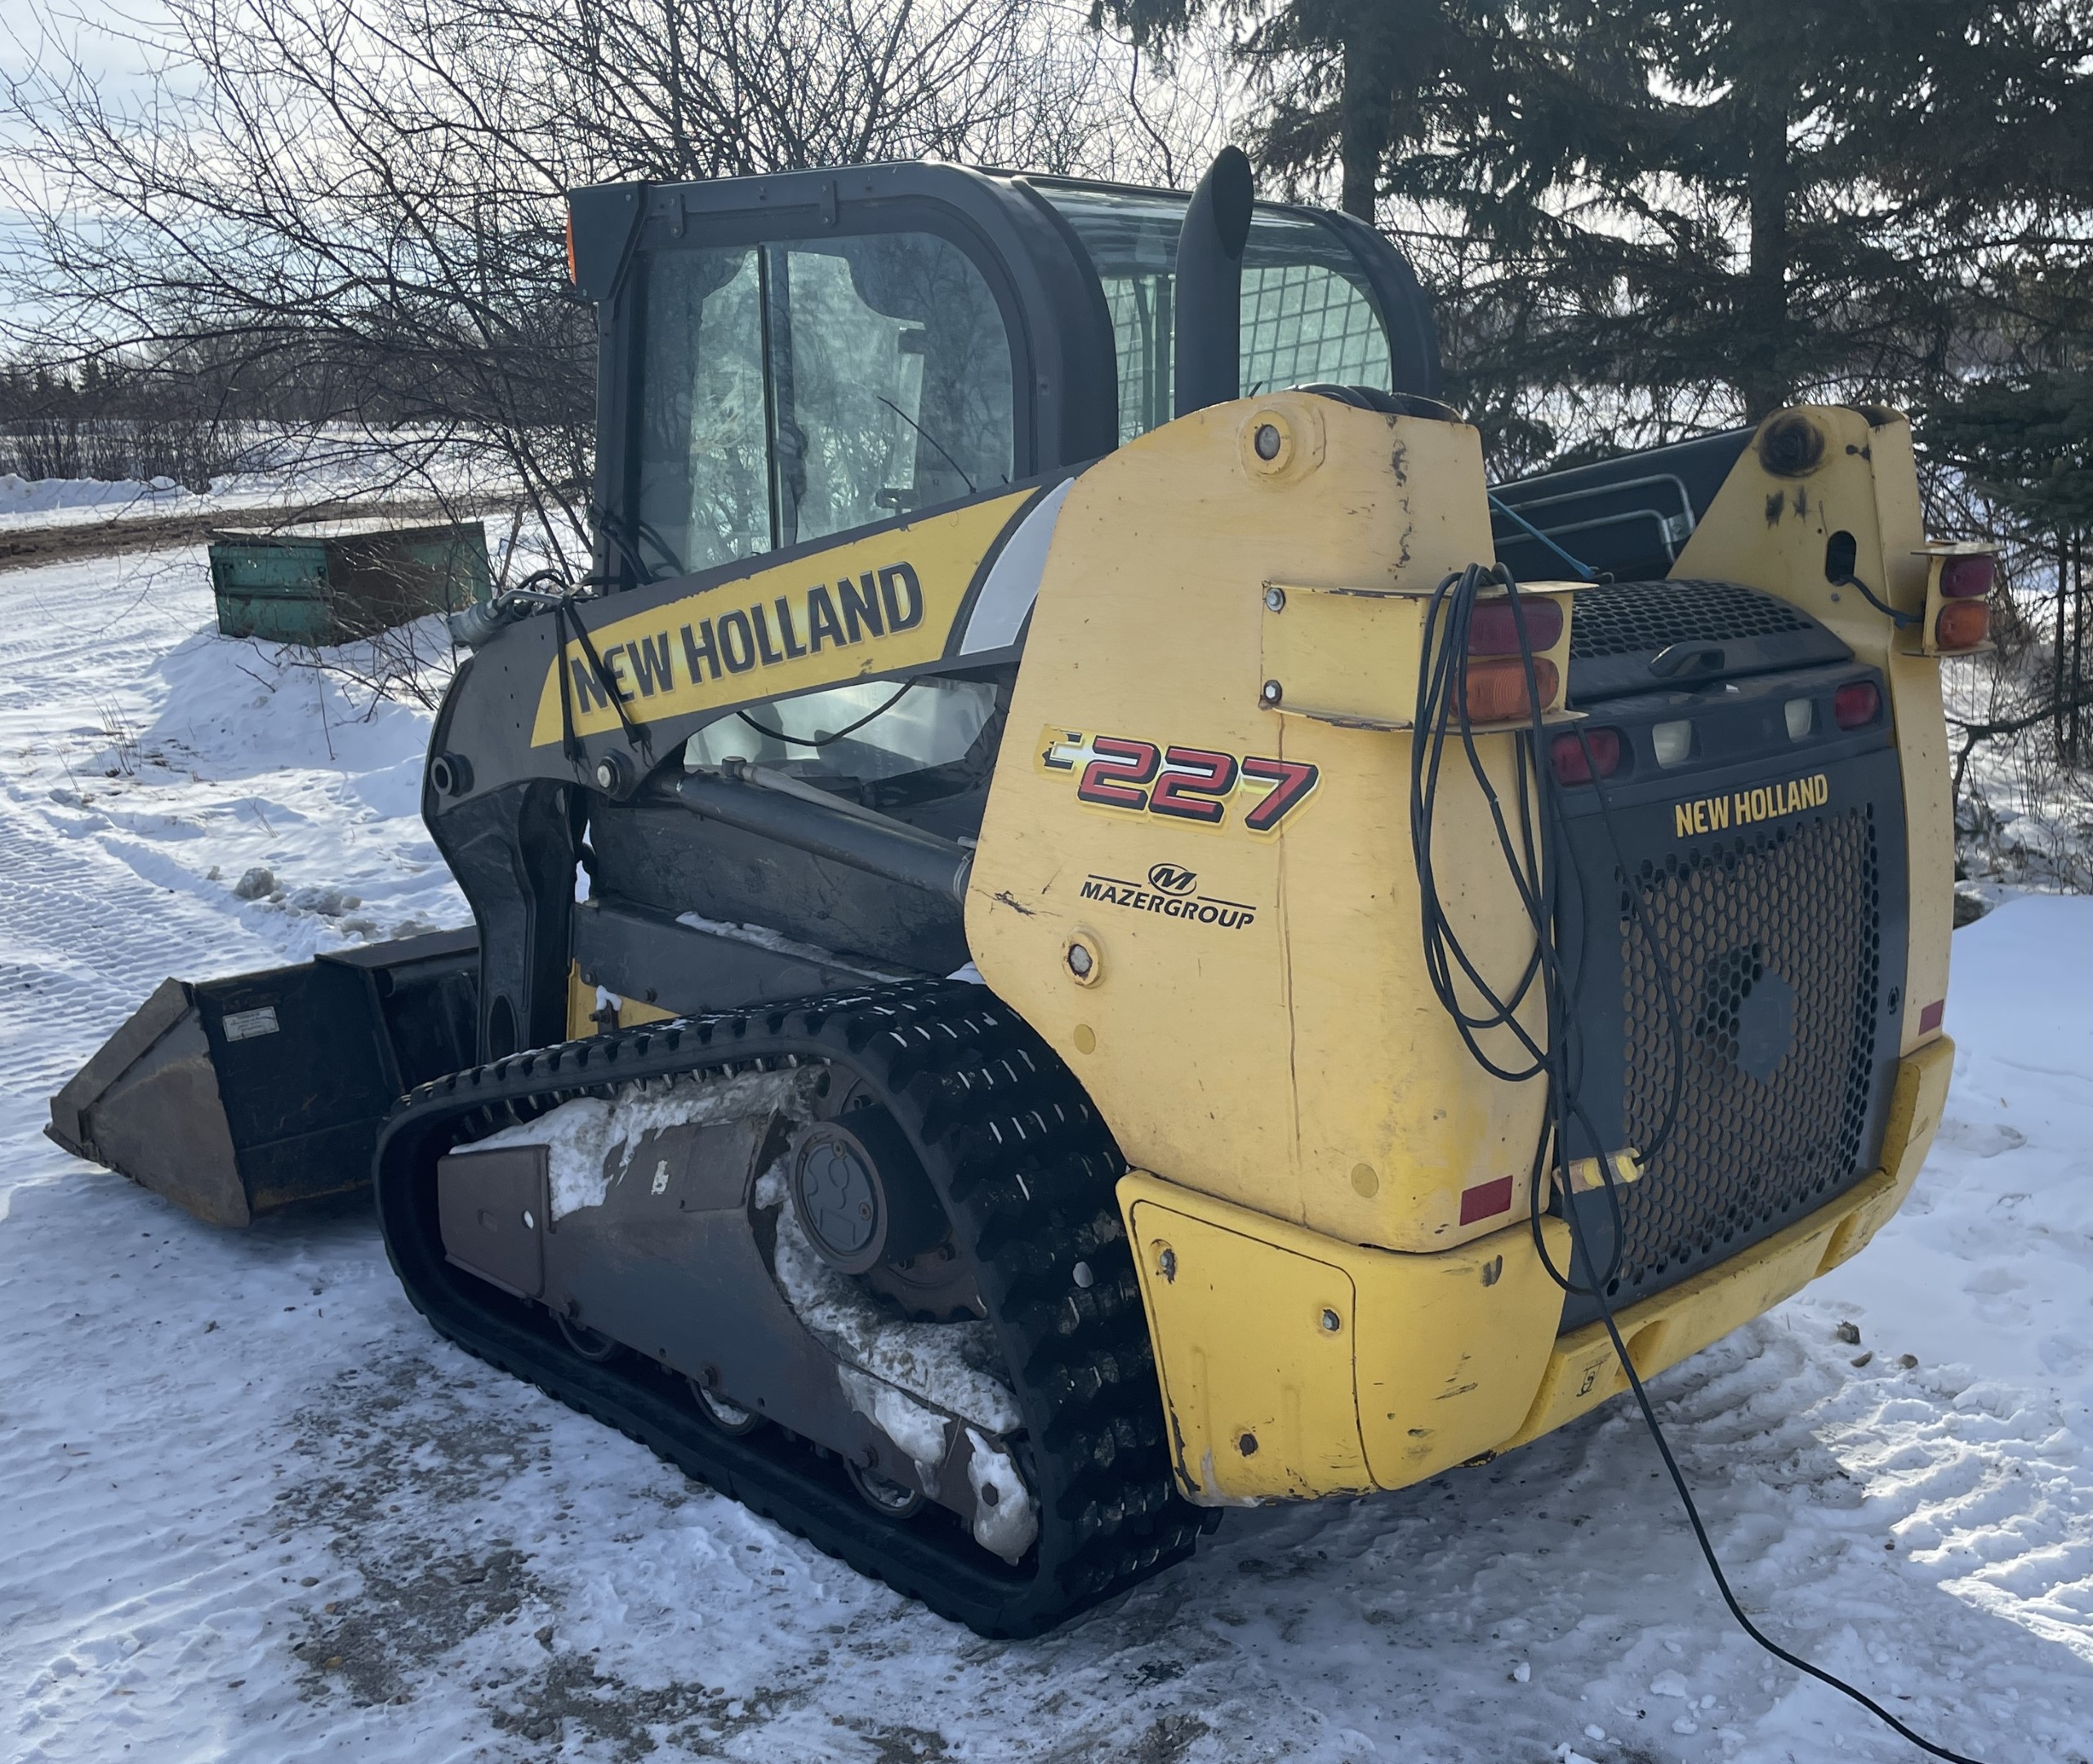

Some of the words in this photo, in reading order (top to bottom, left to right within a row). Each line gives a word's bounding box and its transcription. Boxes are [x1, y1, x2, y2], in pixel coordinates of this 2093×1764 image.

[571, 630, 674, 715] NEW
[680, 561, 924, 684] HOLLAND
[1675, 795, 1729, 838] NEW
[1734, 773, 1828, 826] HOLLAND
[1080, 881, 1254, 930] MAZERGROUP
